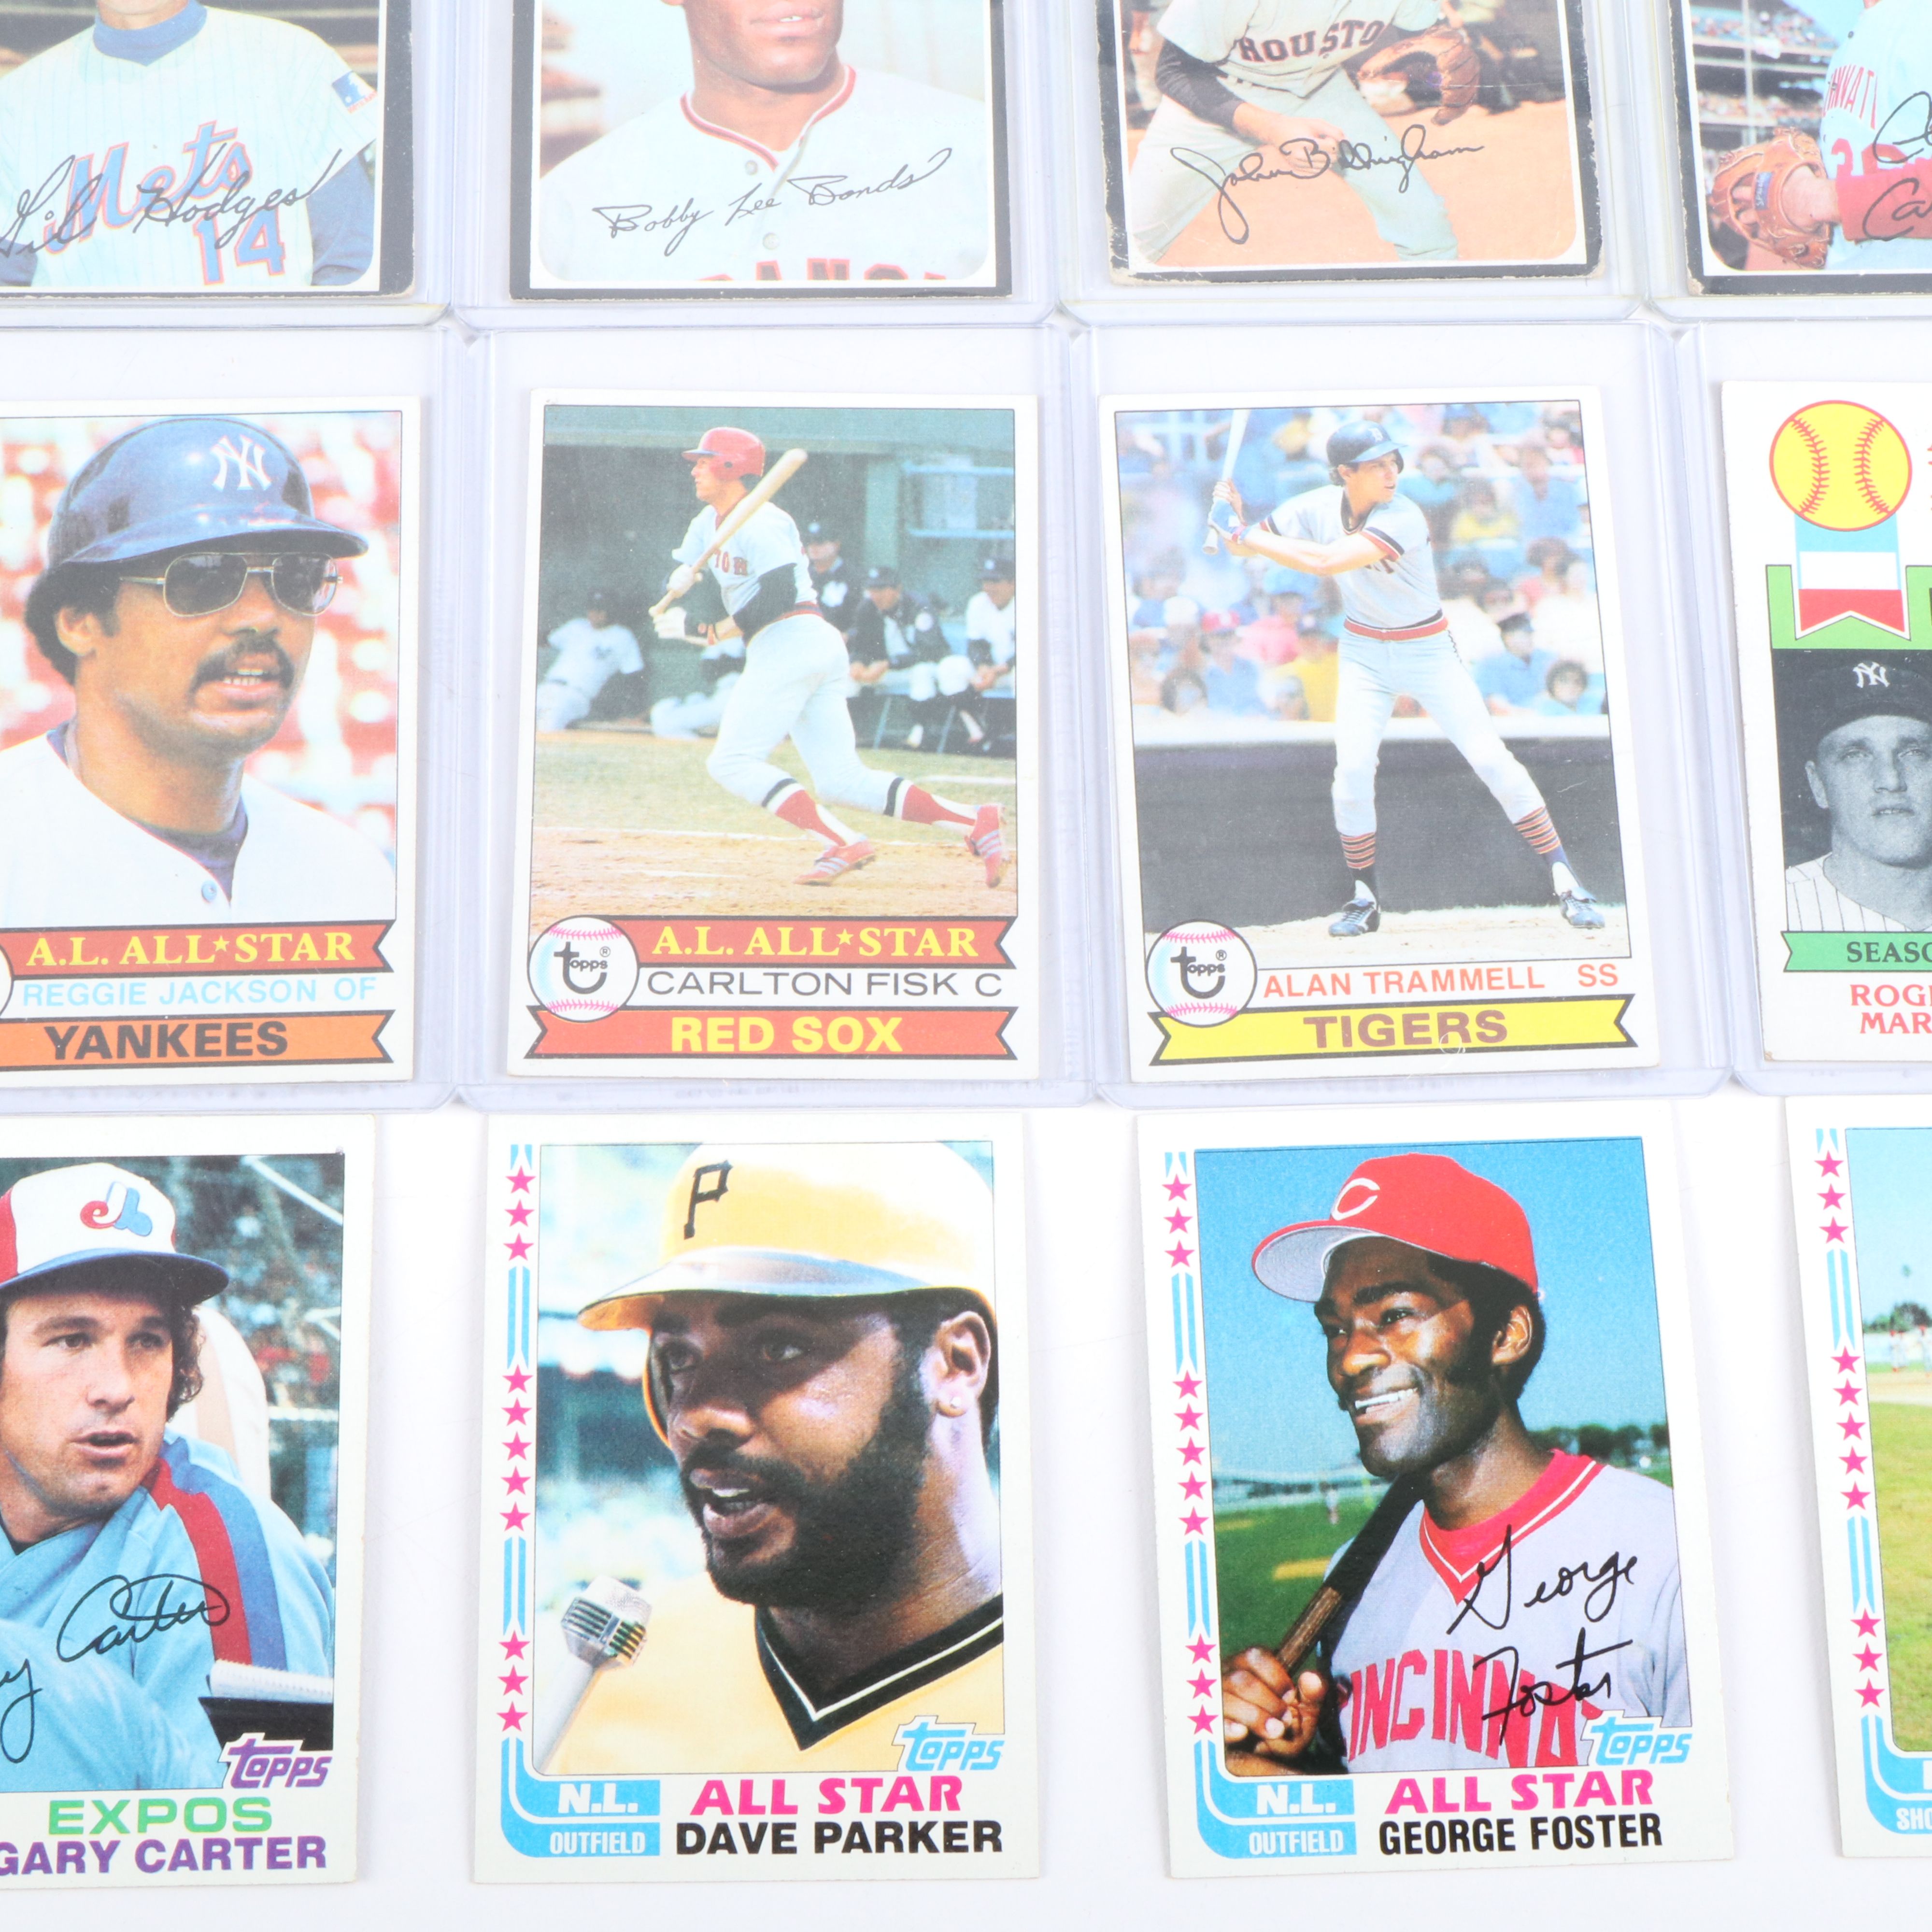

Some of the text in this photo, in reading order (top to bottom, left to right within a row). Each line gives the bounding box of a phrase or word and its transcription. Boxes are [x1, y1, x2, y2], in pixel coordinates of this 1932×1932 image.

[43, 120, 252, 255] Mets
[134, 143, 343, 249] Hodges
[592, 147, 952, 256] Bobby Lee Bonds
[193, 207, 285, 285] 14
[26, 937, 109, 966] A.L.
[652, 926, 734, 955] A.L.
[554, 941, 608, 994] topps
[648, 971, 1002, 997] CARLTON FISK C
[1170, 947, 1226, 999] topps
[1264, 964, 1618, 998] ALAN TRAMMELL SS
[23, 976, 377, 1007] REGGIE JACKSON OF
[1849, 984, 1932, 1007] ROG
[44, 1021, 288, 1060] YANKEES
[671, 1016, 903, 1052] RED SOX
[1303, 1010, 1507, 1049] TIGERS
[683, 1160, 733, 1240] P
[1330, 1177, 1380, 1221] C
[1447, 1524, 1638, 1634] George
[57, 1574, 230, 1662] Carter
[1474, 1627, 1633, 1746] Foster
[902, 1721, 1005, 1771] topps
[1589, 1717, 1691, 1766] topps
[228, 1739, 332, 1788] topps
[558, 1783, 638, 1813] N.L.
[690, 1775, 963, 1816] ALL STAR
[1256, 1785, 1335, 1814] N.L.
[1384, 1770, 1654, 1814] ALL STAR
[49, 1797, 272, 1834] EXPOS
[1379, 1813, 1663, 1855] GEORGE FOSTER
[0, 1836, 327, 1875] GARY CARTER
[550, 1832, 645, 1855] OUTFIELD
[677, 1820, 1003, 1855] DAVE PARKER
[1249, 1829, 1344, 1855] OUTFIELD
